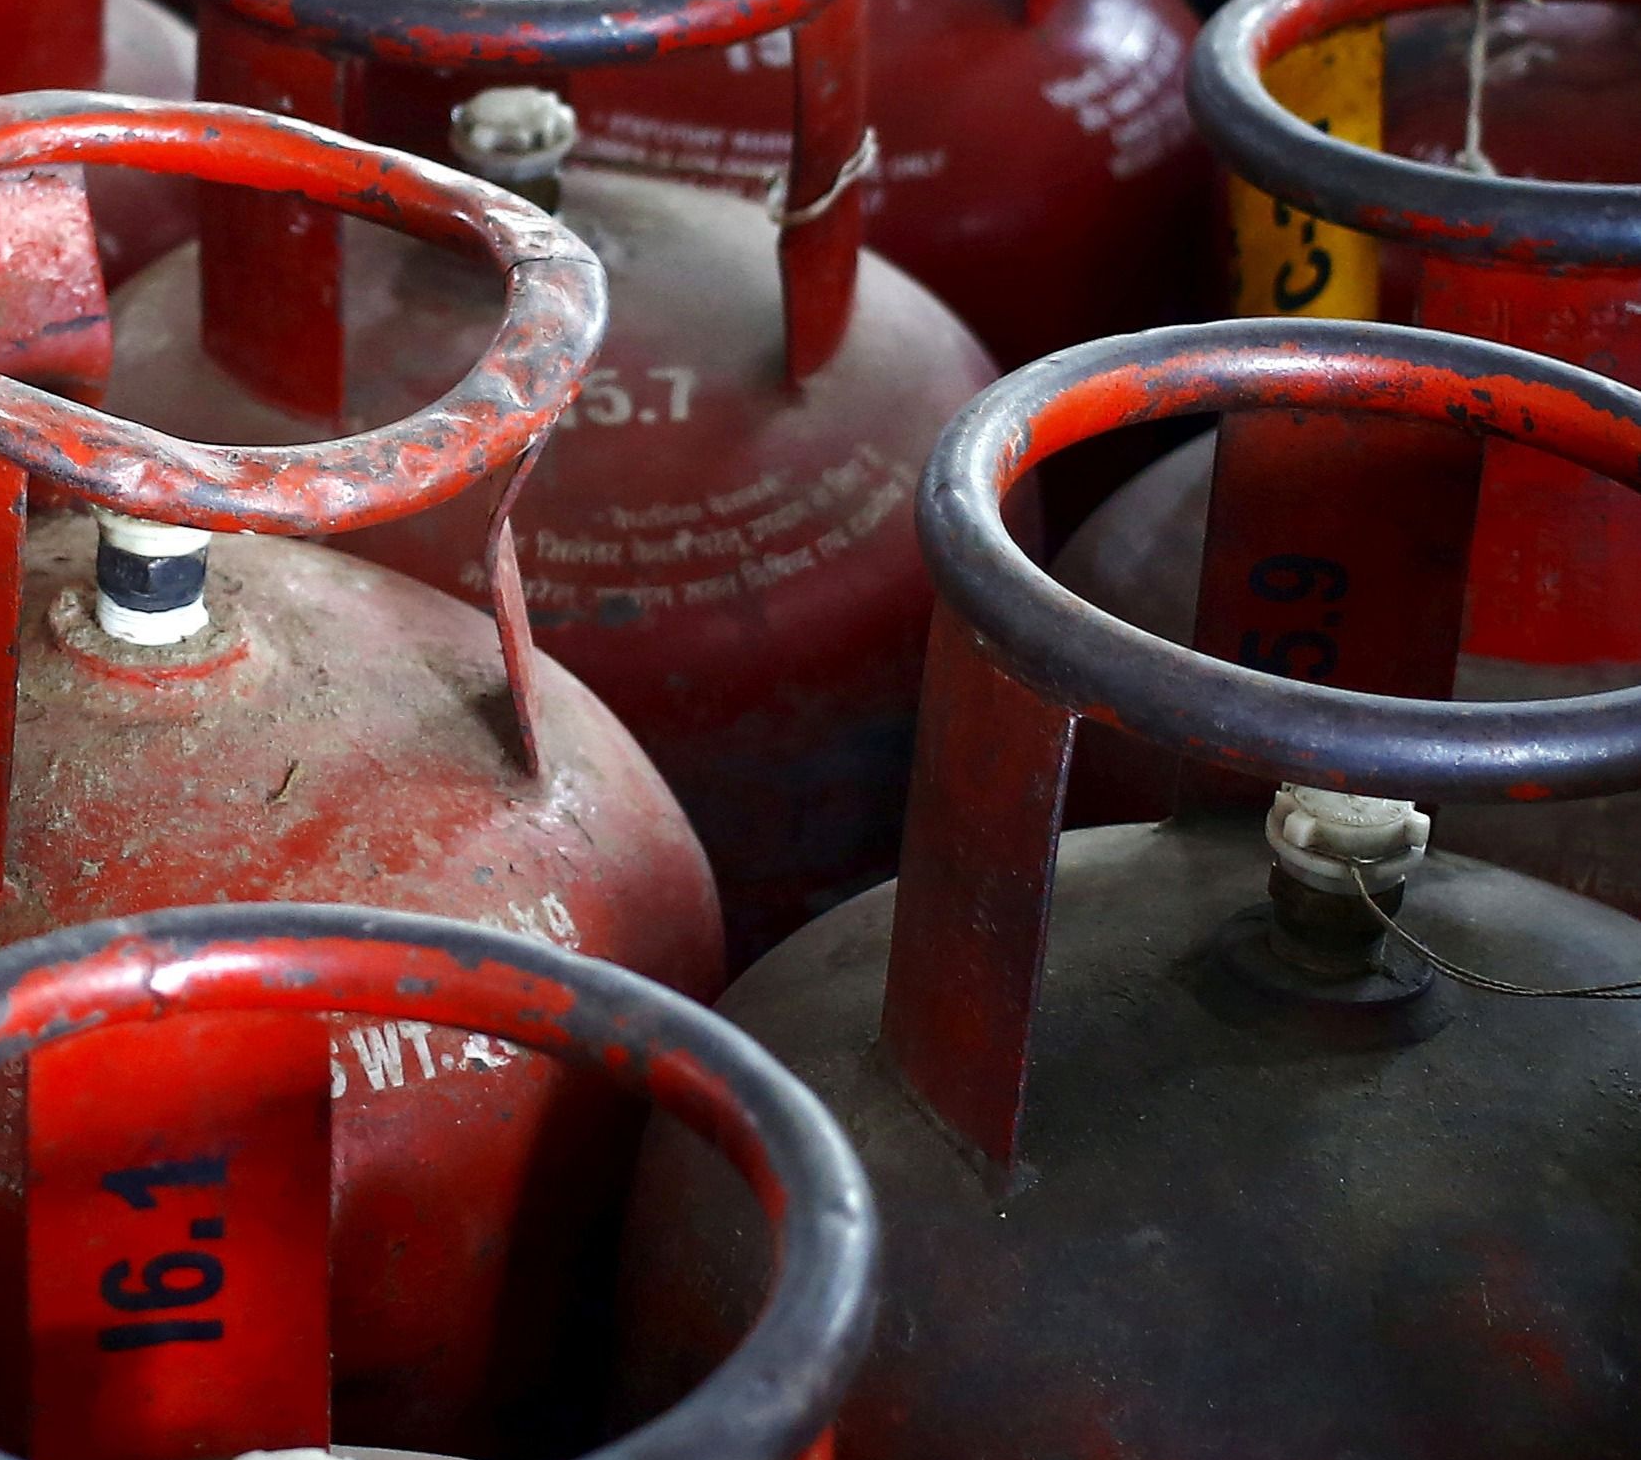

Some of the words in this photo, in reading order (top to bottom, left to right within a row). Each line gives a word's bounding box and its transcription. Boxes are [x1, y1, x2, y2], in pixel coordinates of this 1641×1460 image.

[561, 366, 698, 429] 5.7
[1240, 554, 1350, 679] 5.9
[100, 1154, 230, 1351] 16.1
